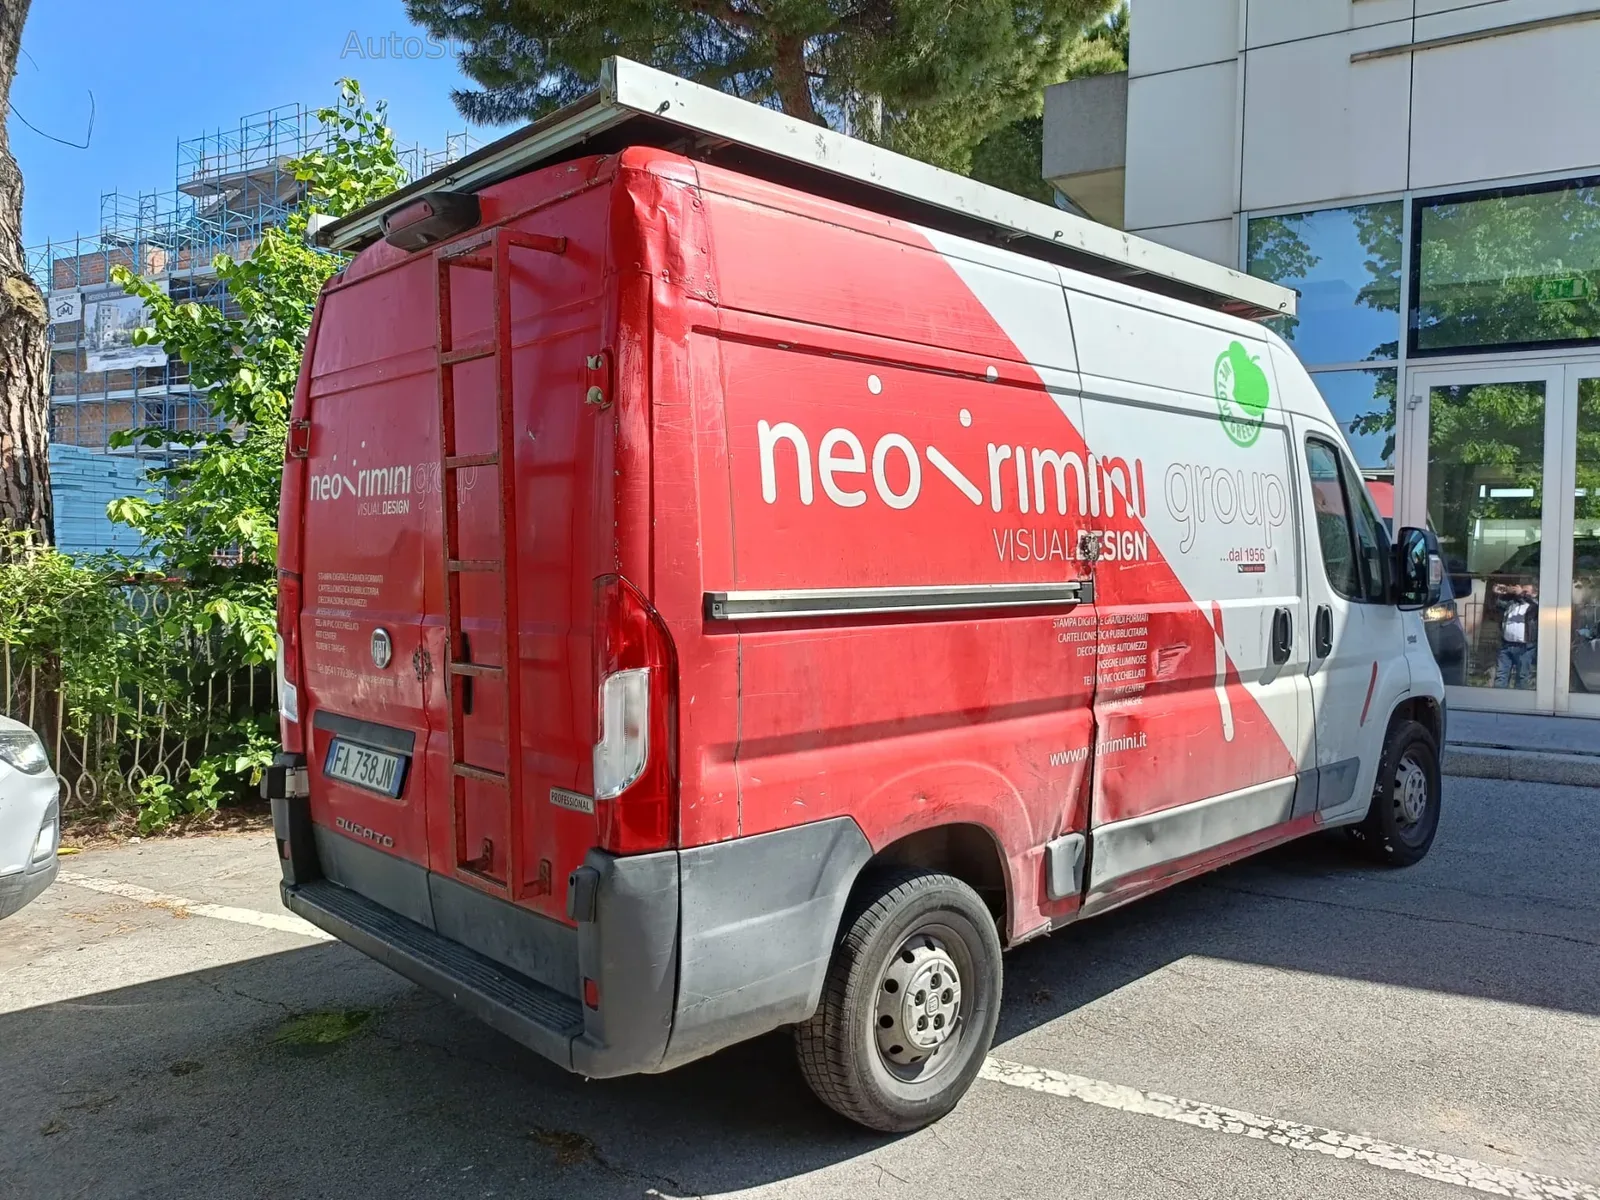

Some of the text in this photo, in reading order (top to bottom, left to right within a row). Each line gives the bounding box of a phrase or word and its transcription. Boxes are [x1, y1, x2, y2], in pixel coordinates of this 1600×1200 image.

[1163, 462, 1286, 555] group
[1245, 548, 1265, 561] 1956
[1052, 617, 1077, 629] STAMPA
[1078, 616, 1104, 627] DIGITAE
[332, 745, 351, 776] FA
[551, 790, 591, 811] PROFESSIONAL
